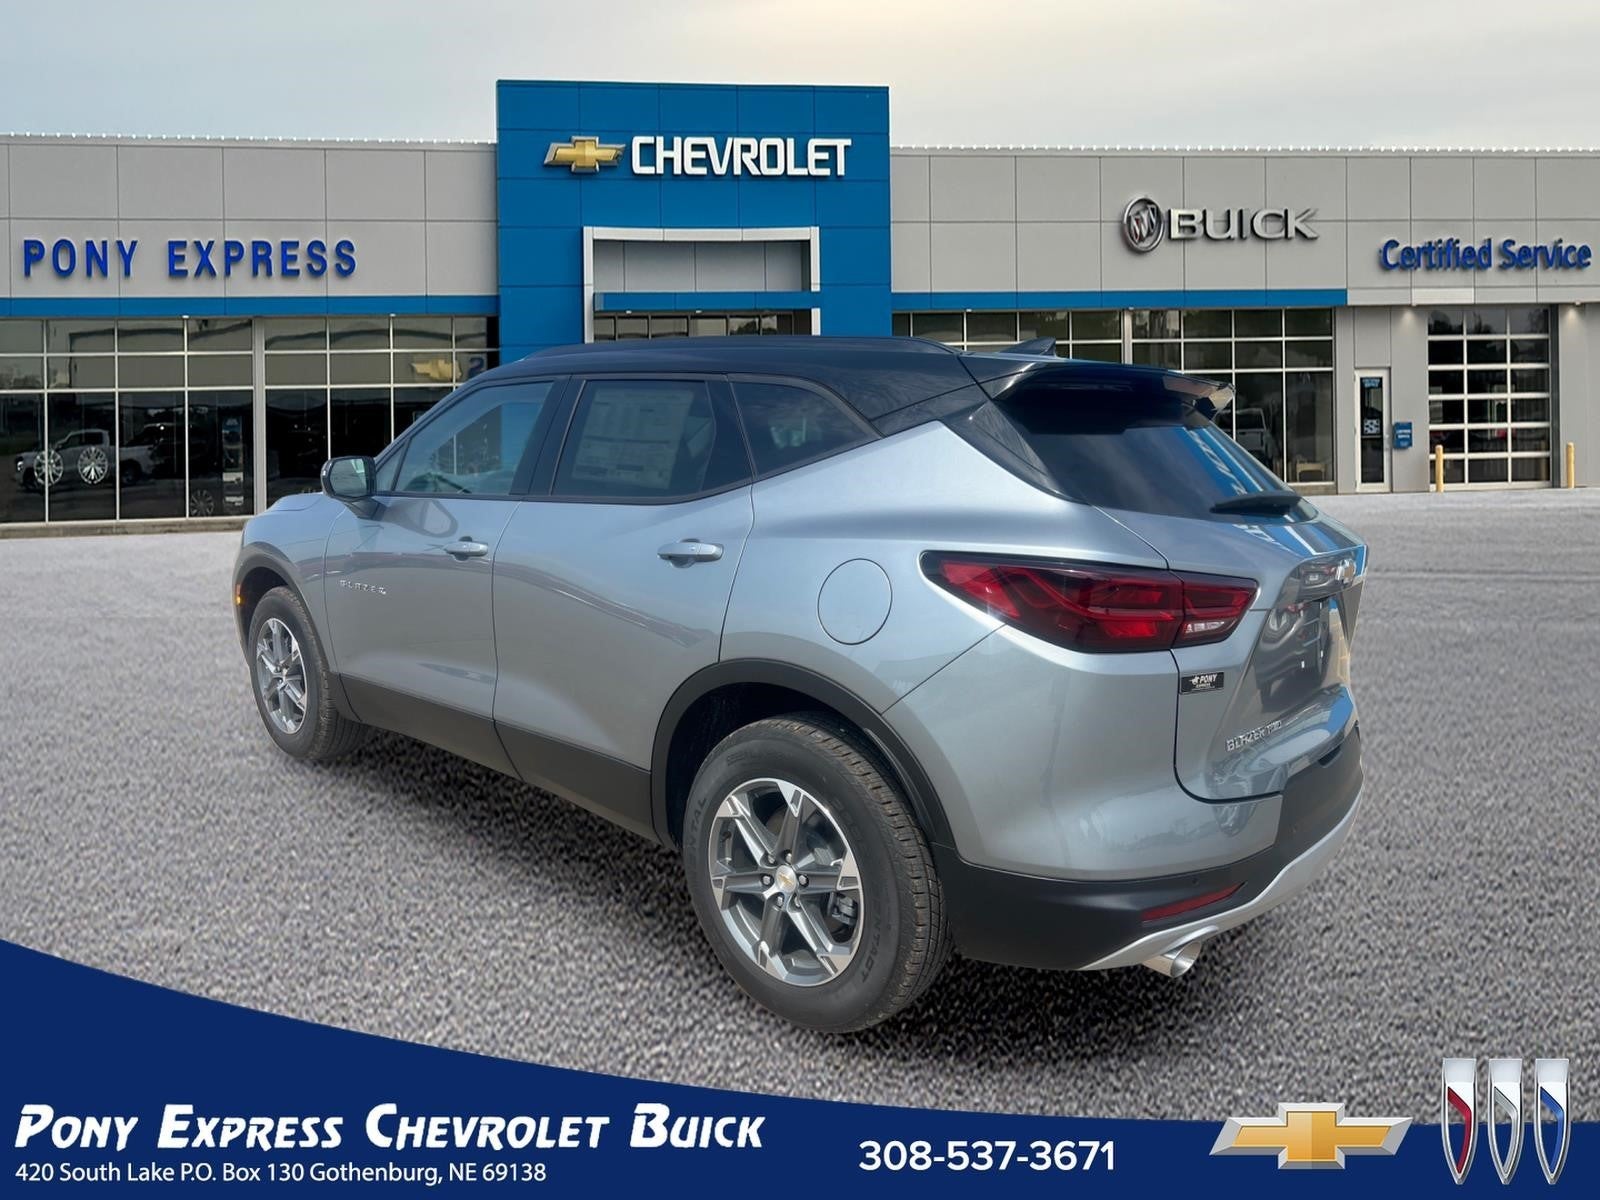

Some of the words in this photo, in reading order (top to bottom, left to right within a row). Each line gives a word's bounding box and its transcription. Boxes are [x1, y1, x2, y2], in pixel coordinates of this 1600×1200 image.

[631, 136, 852, 176] CHEVROLET
[1169, 207, 1319, 241] BUICK
[23, 239, 138, 278] PONY
[168, 240, 357, 278] EXPRESS
[1380, 238, 1493, 271] Certified
[1500, 238, 1593, 271] Service
[1199, 673, 1218, 684] PONY
[1225, 726, 1266, 752] BLAZER
